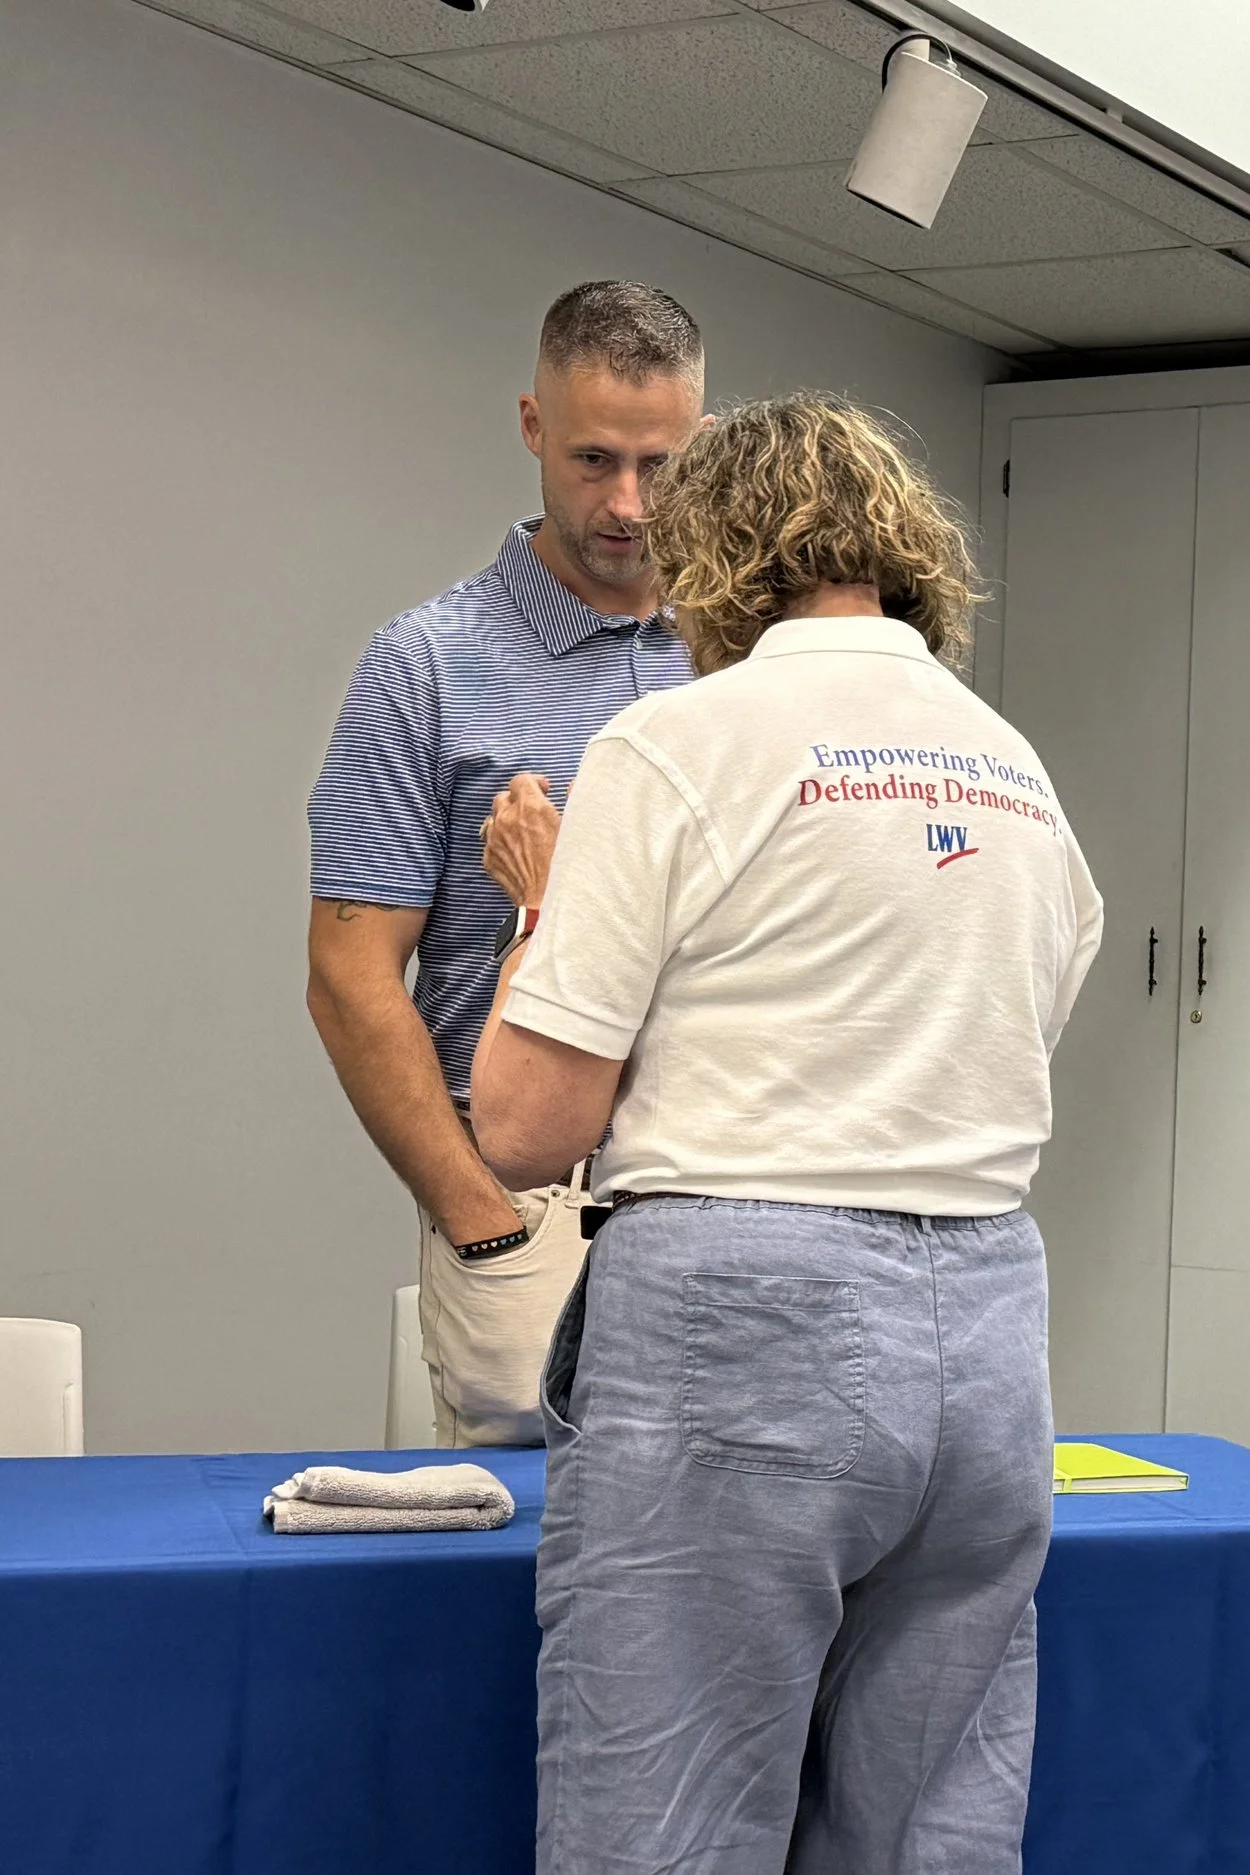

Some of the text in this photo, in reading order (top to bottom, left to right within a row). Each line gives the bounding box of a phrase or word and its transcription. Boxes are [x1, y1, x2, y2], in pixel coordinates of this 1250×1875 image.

[810, 743, 1049, 798] Empowering Voters.
[797, 773, 1063, 837] Defending Democracy.
[926, 823, 968, 853] LWV
